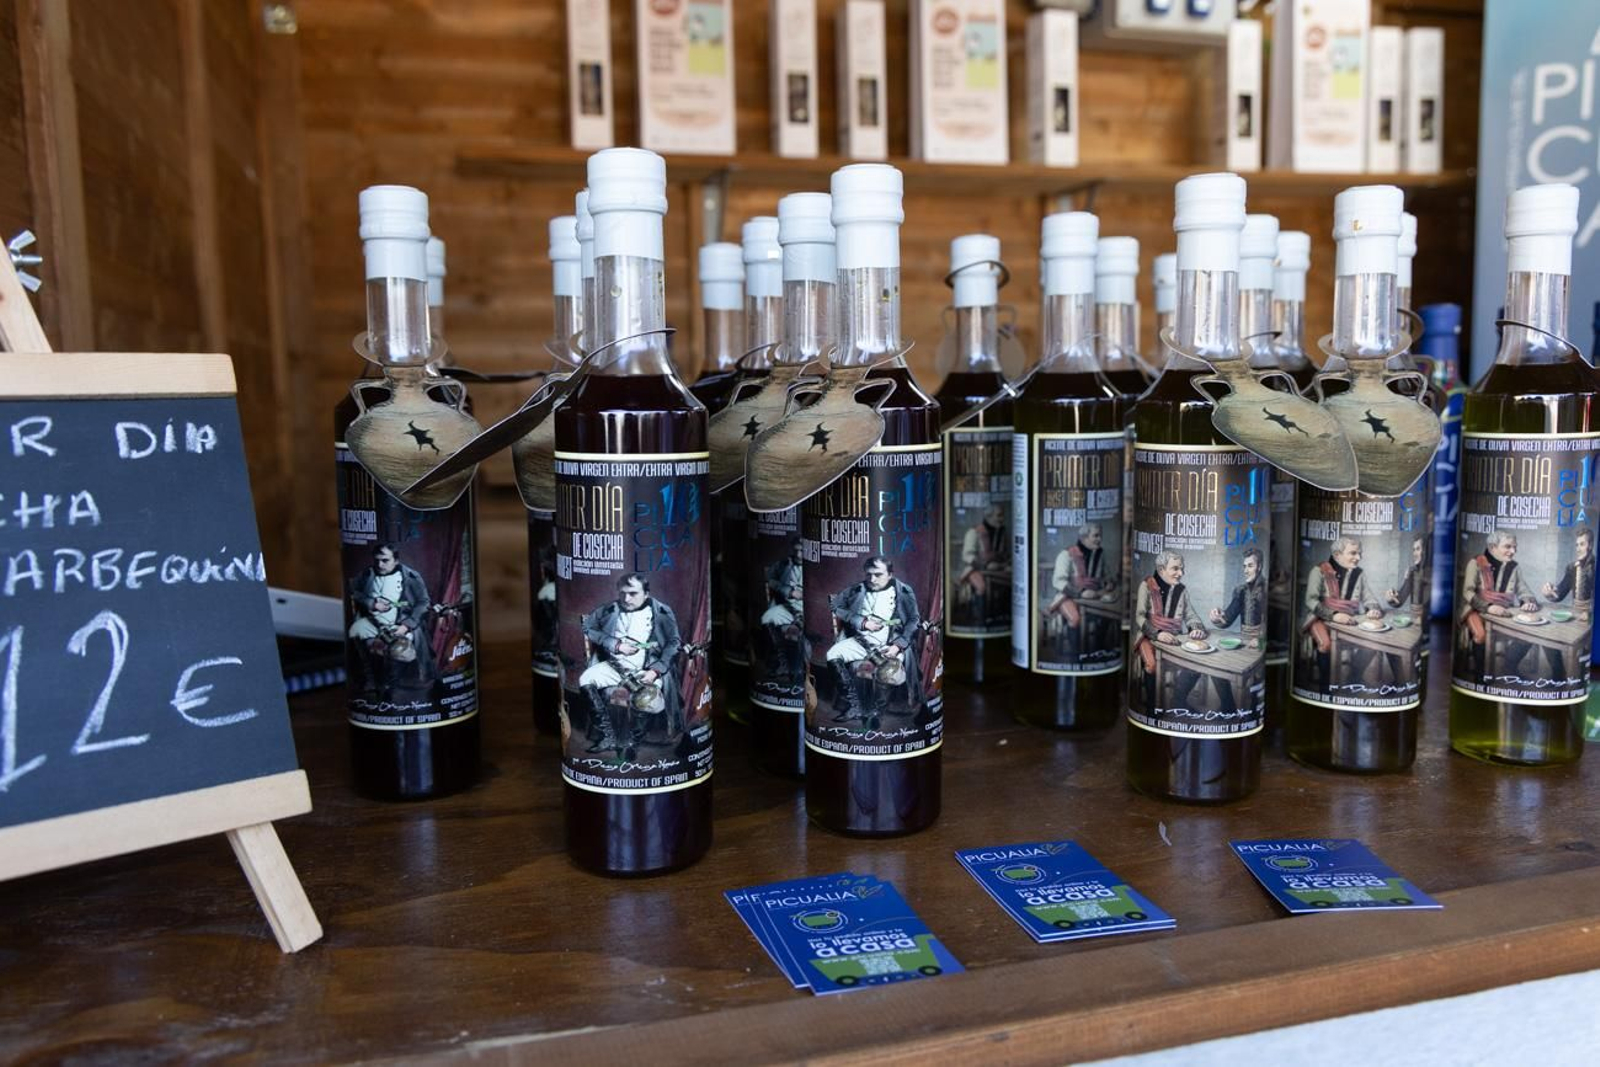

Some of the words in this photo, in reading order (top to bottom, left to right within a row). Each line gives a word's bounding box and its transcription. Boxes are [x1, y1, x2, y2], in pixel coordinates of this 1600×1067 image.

[1511, 440, 1540, 451] VIRGEN
[1177, 452, 1206, 465] VIRGEN
[580, 462, 609, 476] VIRGEN
[1043, 454, 1100, 488] PRIMER
[1521, 454, 1552, 494] DÍA
[840, 472, 869, 517] DÍA
[1189, 468, 1218, 511] DÍA
[592, 481, 624, 532] DÍA
[1342, 501, 1353, 522] DE
[1355, 501, 1394, 522] COSECHA
[1497, 496, 1508, 516] DE
[1510, 496, 1551, 518] COSECHA
[821, 519, 830, 543] DE
[831, 519, 870, 544] COSECHA
[1165, 513, 1176, 536] DE
[1178, 514, 1217, 537] COSECHA
[572, 532, 582, 558] DE
[583, 533, 624, 560] COSECHA
[417, 712, 441, 723] SPAIN
[821, 740, 891, 754] ESPAÑA/PRODUCT
[893, 743, 901, 753] OF
[905, 740, 925, 752] SPAIN
[576, 772, 649, 788] ESPAÑA/PRODUCT
[651, 776, 661, 787] OF
[663, 772, 688, 784] SPAIN
[964, 848, 1046, 863] PICUALIA
[1237, 843, 1325, 853] PICUALIA
[1038, 884, 1106, 896] llevamos
[1312, 879, 1387, 887] casa
[765, 891, 857, 908] PICUALIA
[1026, 896, 1047, 905] a
[1048, 889, 1115, 902] casa
[832, 932, 908, 946] llevamos
[816, 948, 838, 958] a
[839, 938, 917, 954] casa
